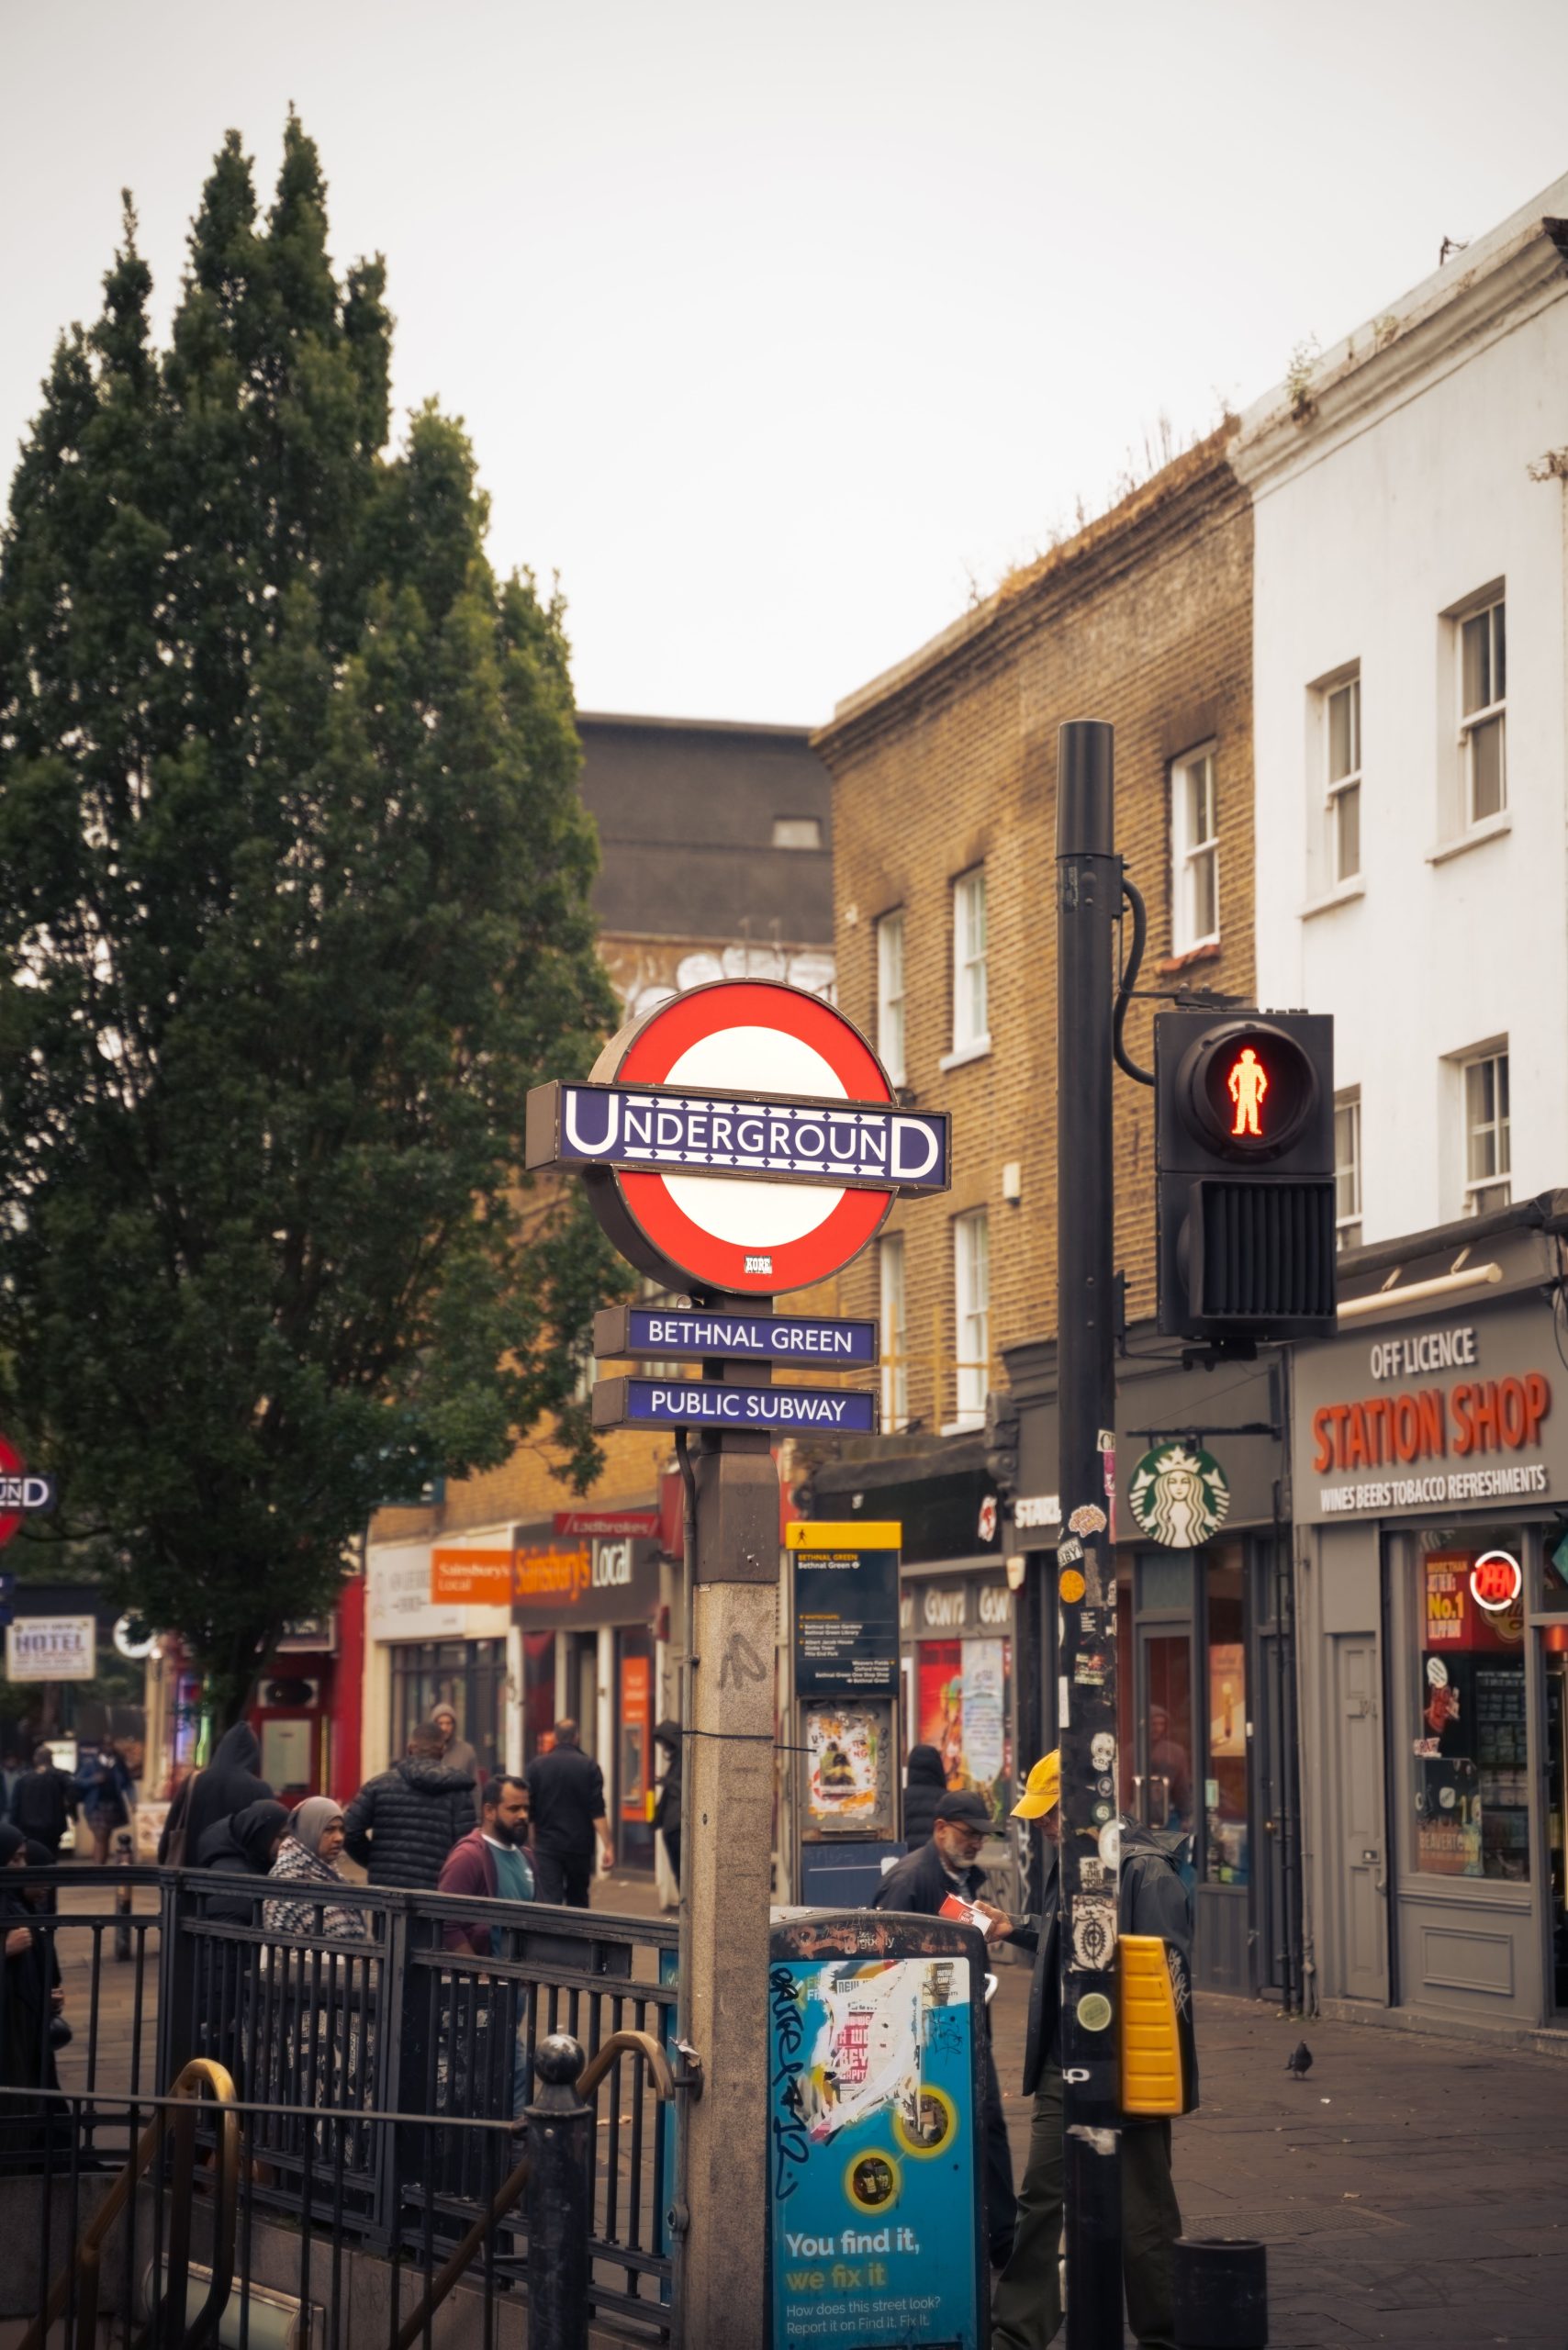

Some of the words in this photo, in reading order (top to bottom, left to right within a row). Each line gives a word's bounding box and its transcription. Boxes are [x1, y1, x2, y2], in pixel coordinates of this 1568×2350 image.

[566, 1090, 939, 1179] UNDERGROUND
[745, 1257, 771, 1272] KORE
[648, 1320, 764, 1348] BETHNAL
[771, 1328, 853, 1353] GREEN
[1371, 1341, 1401, 1379] OFF
[1405, 1328, 1475, 1374] LICENCE
[651, 1391, 741, 1417] PUBLIC
[745, 1396, 846, 1422] SUBWAY
[1313, 1389, 1445, 1473] STATION
[1451, 1373, 1550, 1456] SHOP
[1321, 1487, 1355, 1512] WINES
[1357, 1482, 1391, 1509] BEERS
[1392, 1476, 1446, 1504] TOBACCO
[1448, 1465, 1546, 1499] REFRESHMENTS
[572, 1520, 648, 1535] Ladbrokes
[517, 1540, 590, 1601] Sainsbury's
[593, 1538, 632, 1588] Local
[438, 1578, 471, 1592] Local
[1428, 1591, 1464, 1620] No.1
[16, 1634, 86, 1651] HOTEL
[786, 2232, 834, 2257] You
[840, 2228, 890, 2255] find
[897, 2227, 920, 2255] it,
[786, 2270, 825, 2291] we
[832, 2263, 862, 2288] fix
[868, 2262, 886, 2287] it
[787, 2305, 813, 2317] How
[816, 2302, 846, 2314] does
[848, 2300, 869, 2313] this
[872, 2299, 906, 2311] street
[909, 2296, 941, 2310] look?
[787, 2322, 827, 2335] Report
[830, 2320, 837, 2332] it
[840, 2321, 856, 2331] on
[858, 2317, 884, 2330] Find
[900, 2314, 917, 2327] Fix
